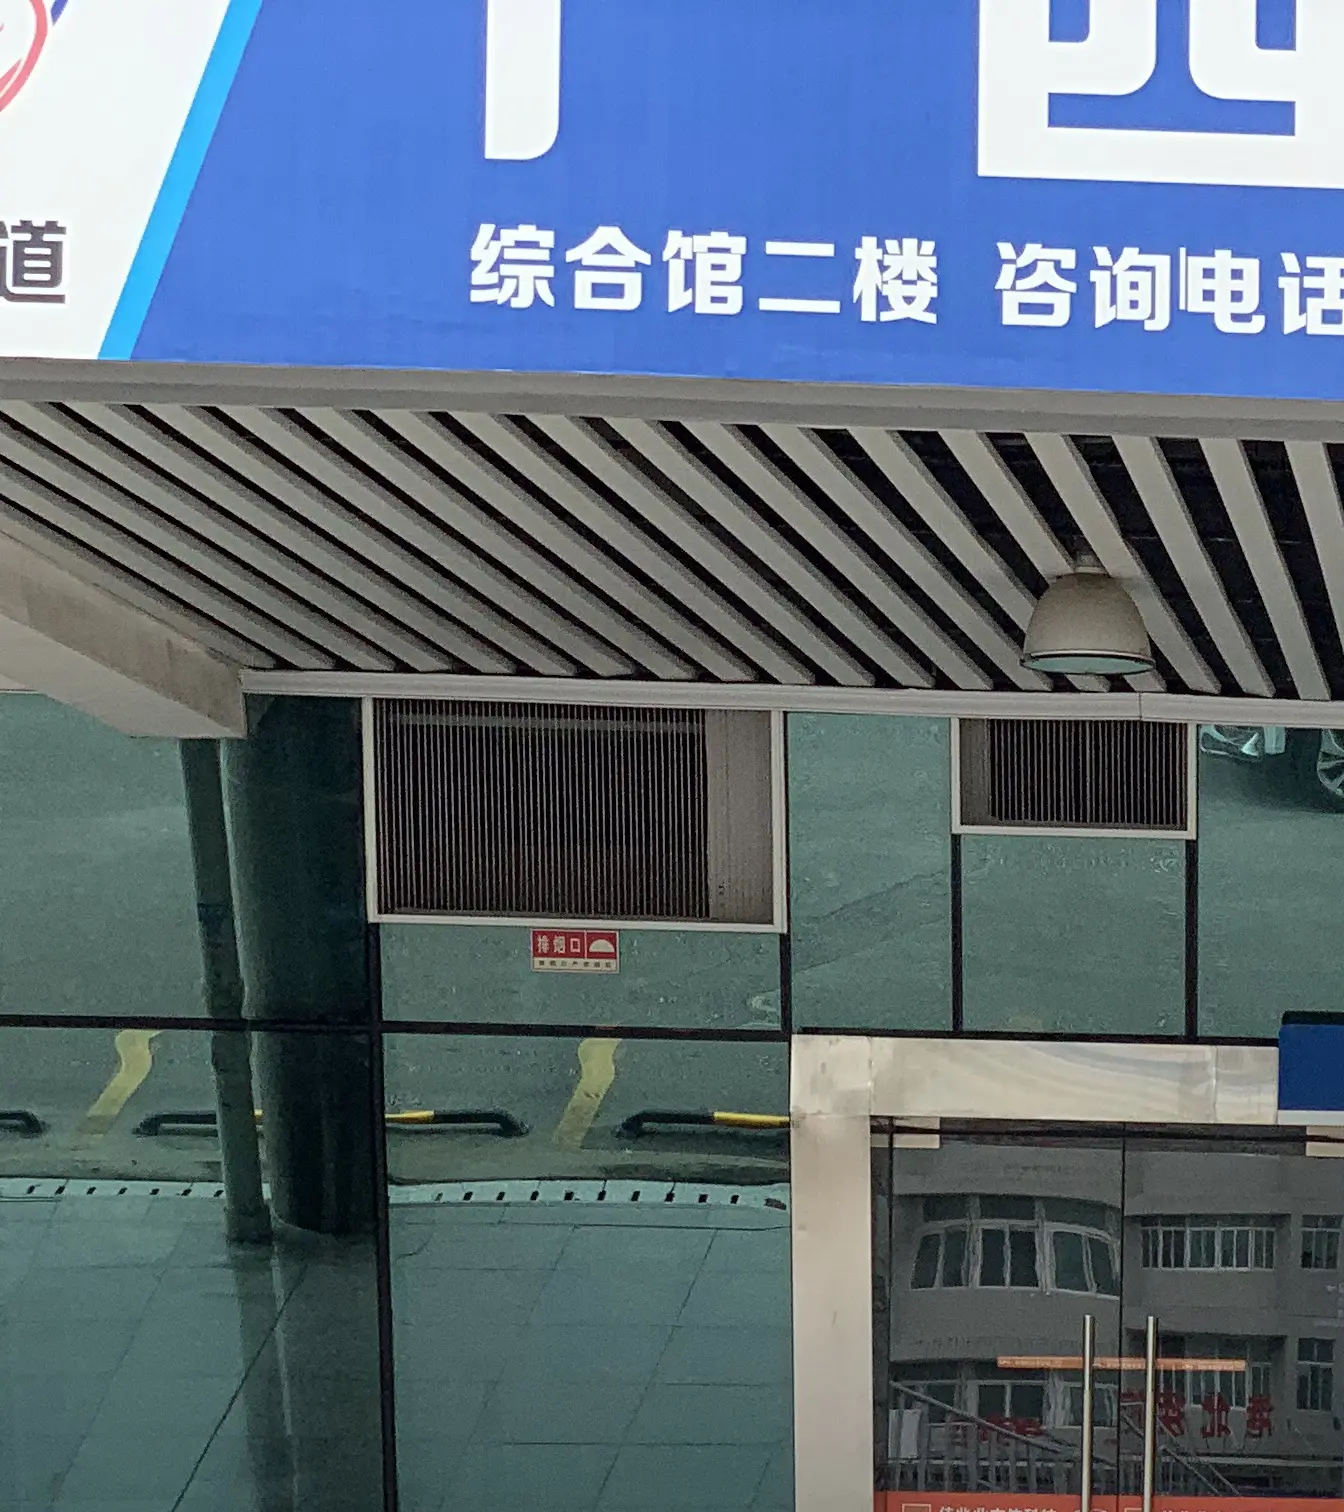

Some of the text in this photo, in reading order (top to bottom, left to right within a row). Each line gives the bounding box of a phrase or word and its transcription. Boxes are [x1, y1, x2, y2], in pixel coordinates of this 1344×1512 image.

[469, 223, 938, 325] 综合馆二楼
